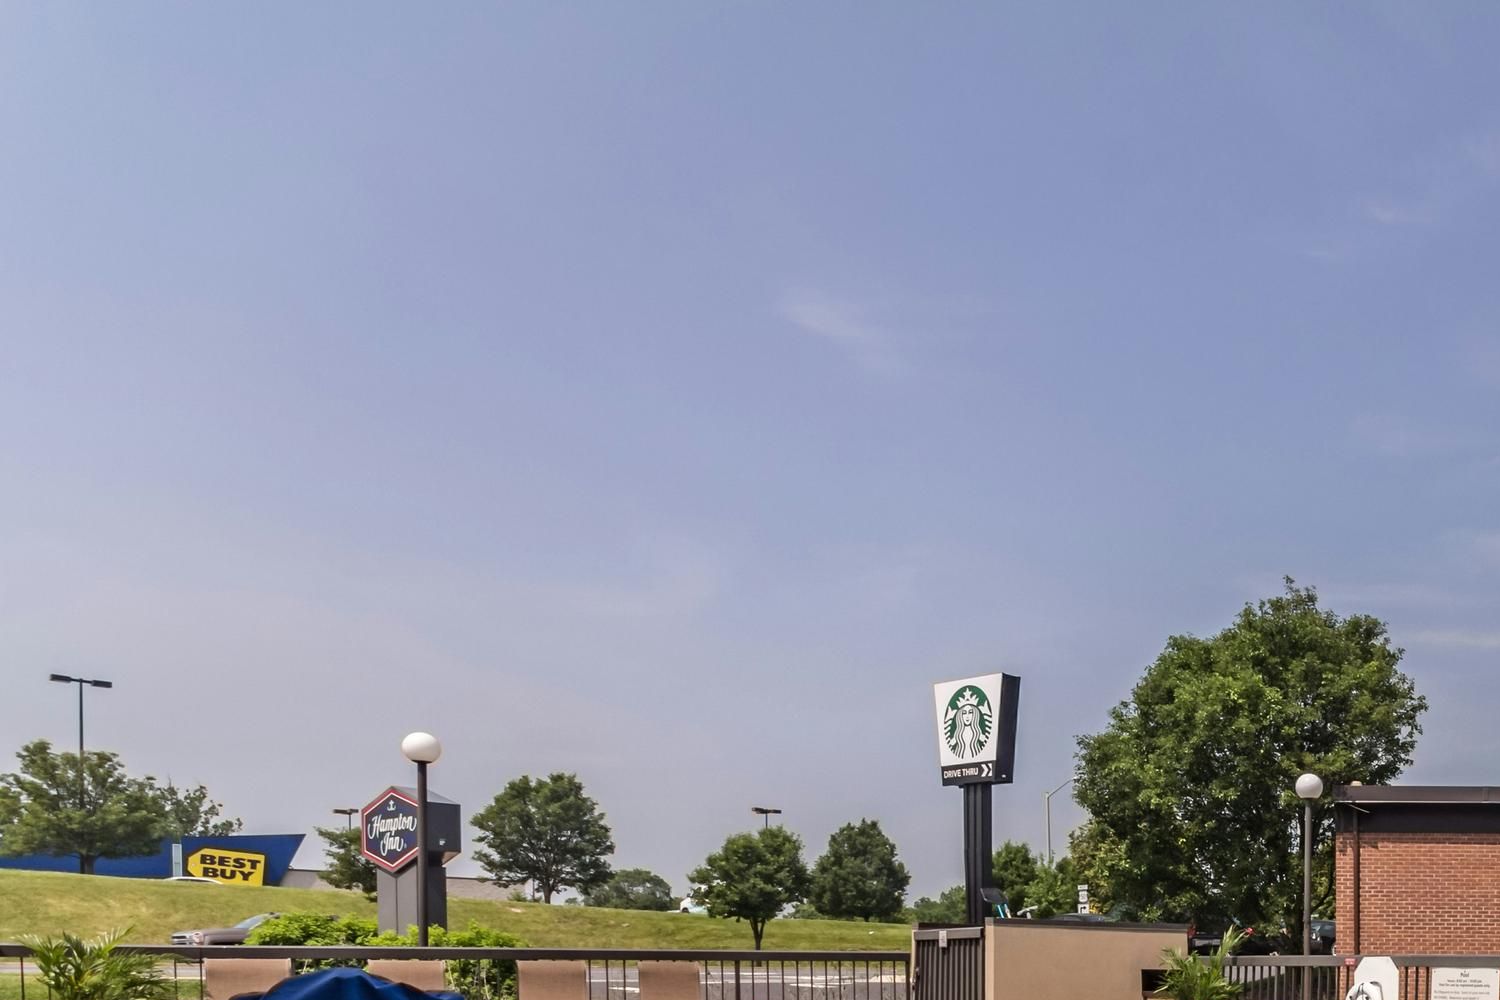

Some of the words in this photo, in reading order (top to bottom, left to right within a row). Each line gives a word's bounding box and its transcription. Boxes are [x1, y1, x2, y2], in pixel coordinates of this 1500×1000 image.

[943, 769, 961, 779] DRIVE
[962, 767, 979, 776] THRU
[367, 813, 417, 840] Hampton
[380, 832, 404, 856] Inn
[200, 854, 261, 870] BEST
[203, 867, 255, 881] BUY
